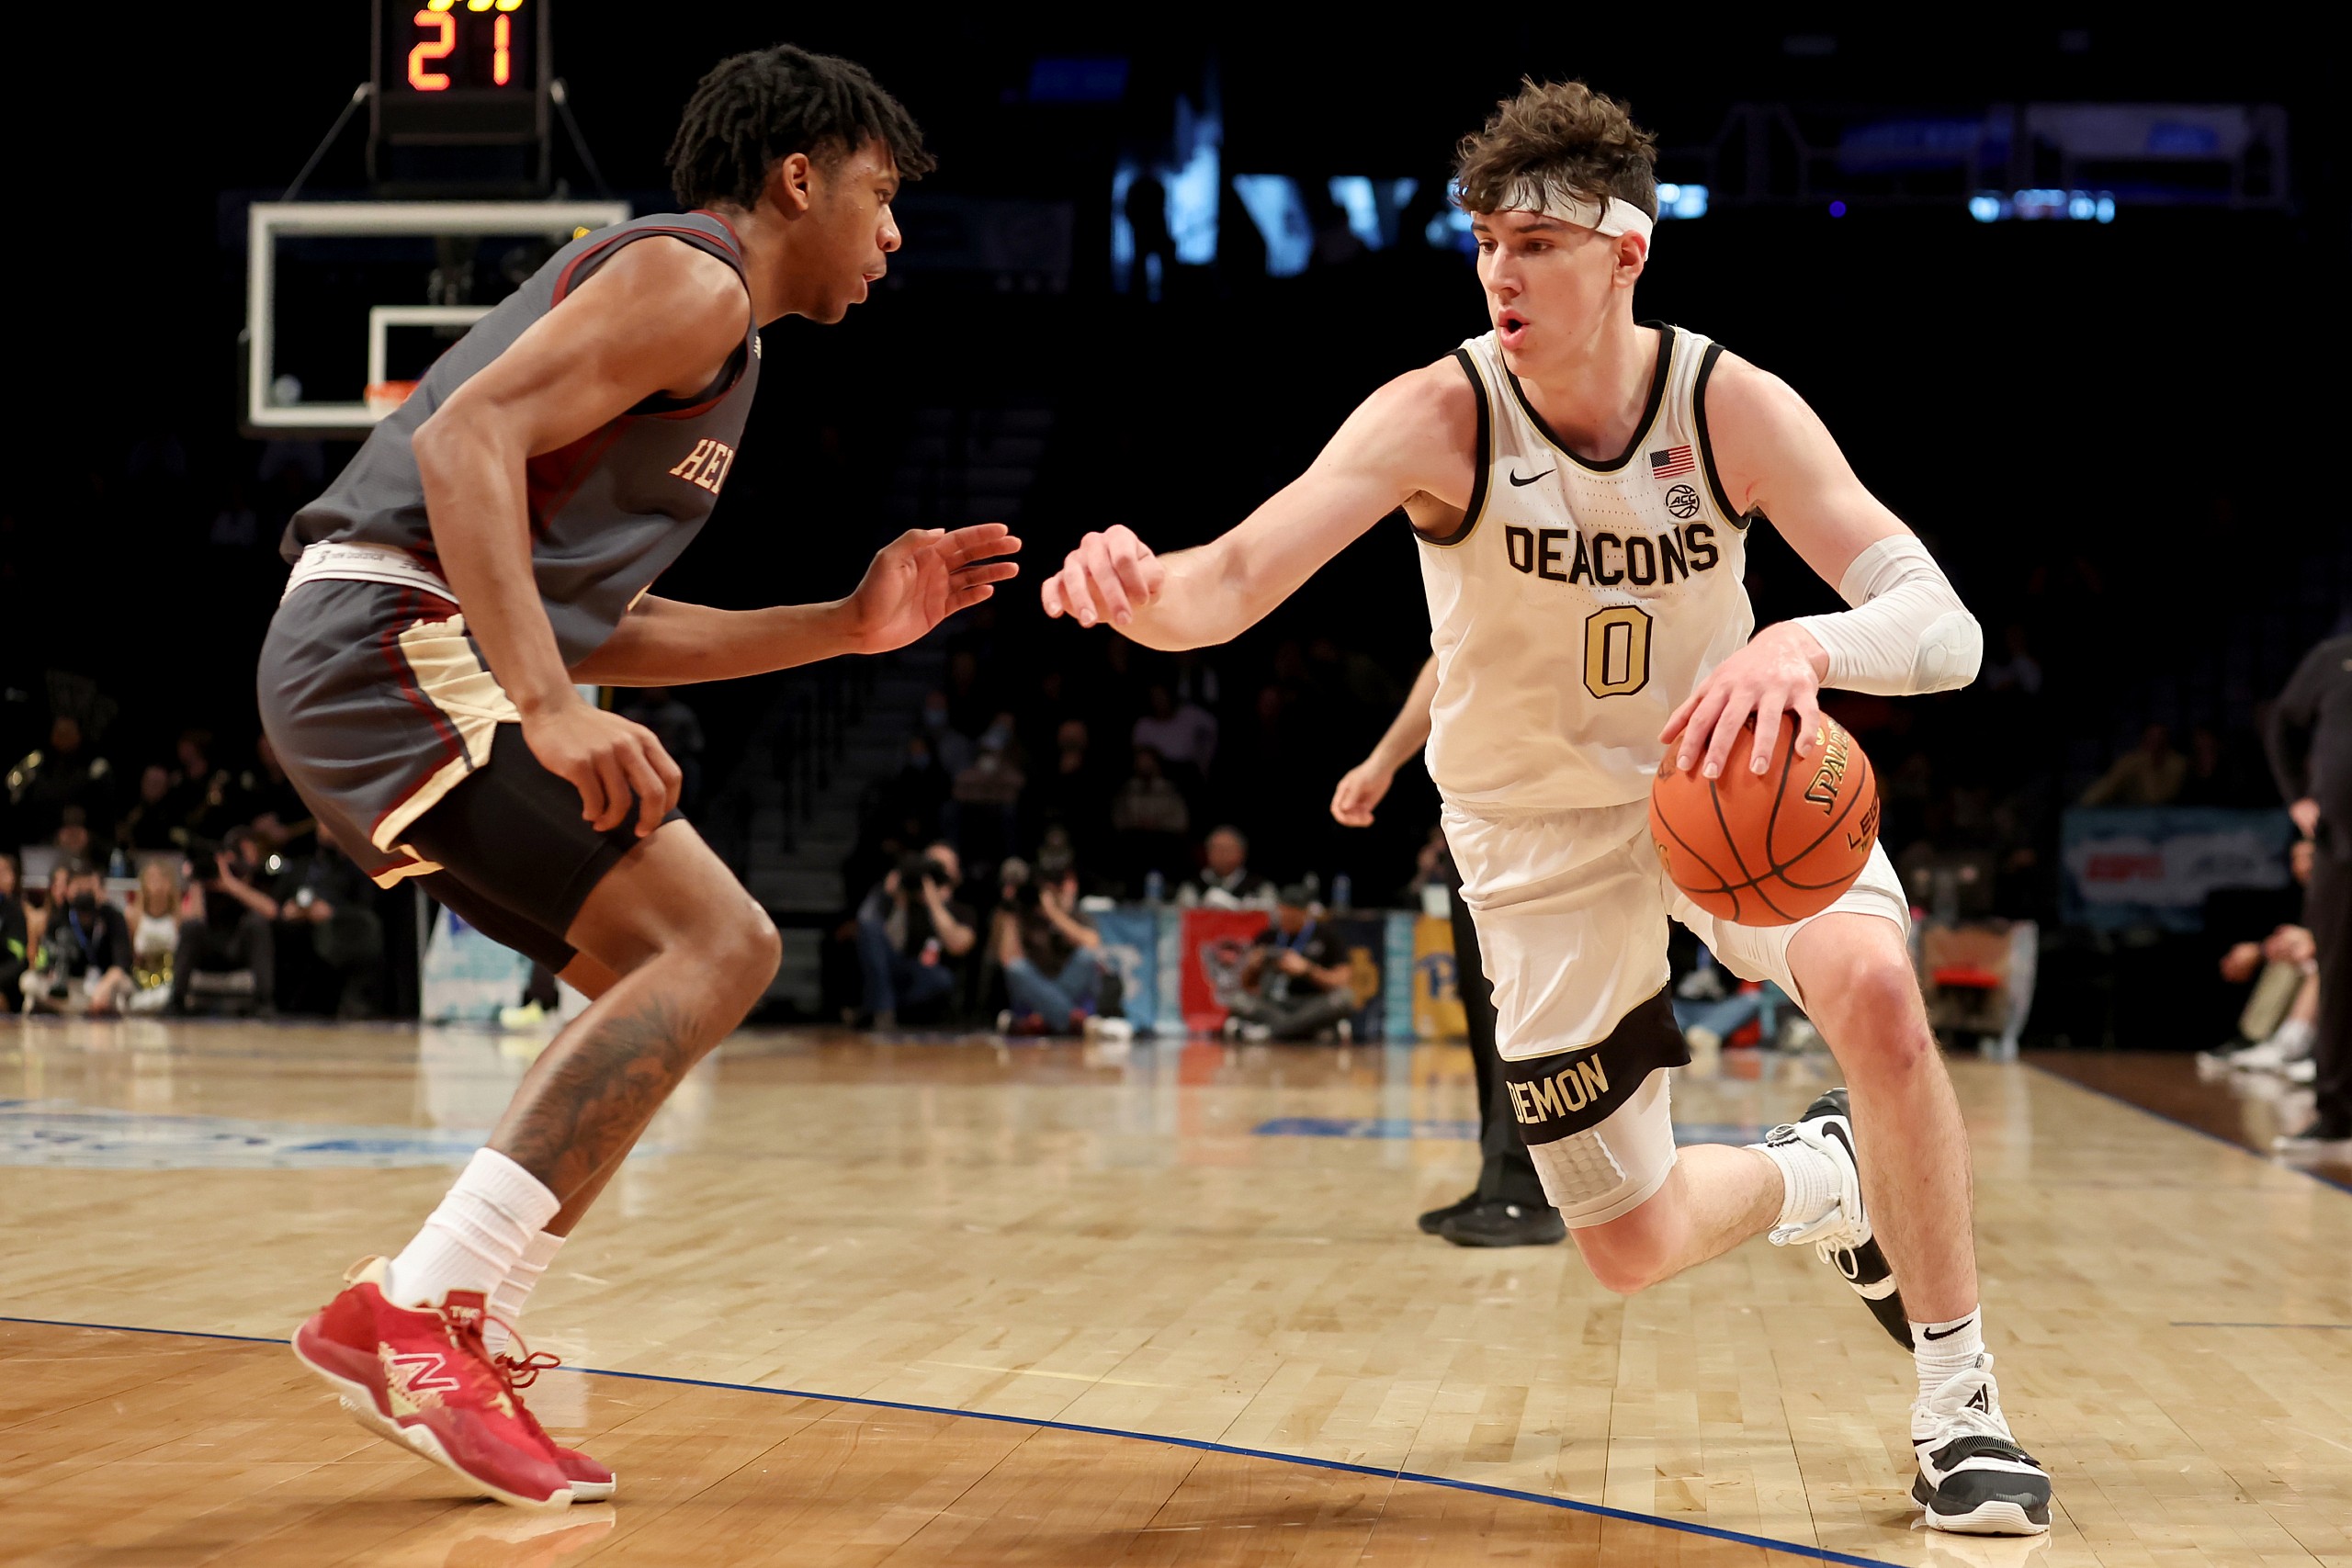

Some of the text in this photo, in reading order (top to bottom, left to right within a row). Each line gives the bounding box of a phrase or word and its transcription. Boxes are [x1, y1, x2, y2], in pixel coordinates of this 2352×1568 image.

[408, 9, 510, 91] 21
[1505, 523, 1719, 586] DEACONS
[1583, 605, 1653, 699] 0
[1506, 1053, 1609, 1124] DEMON
